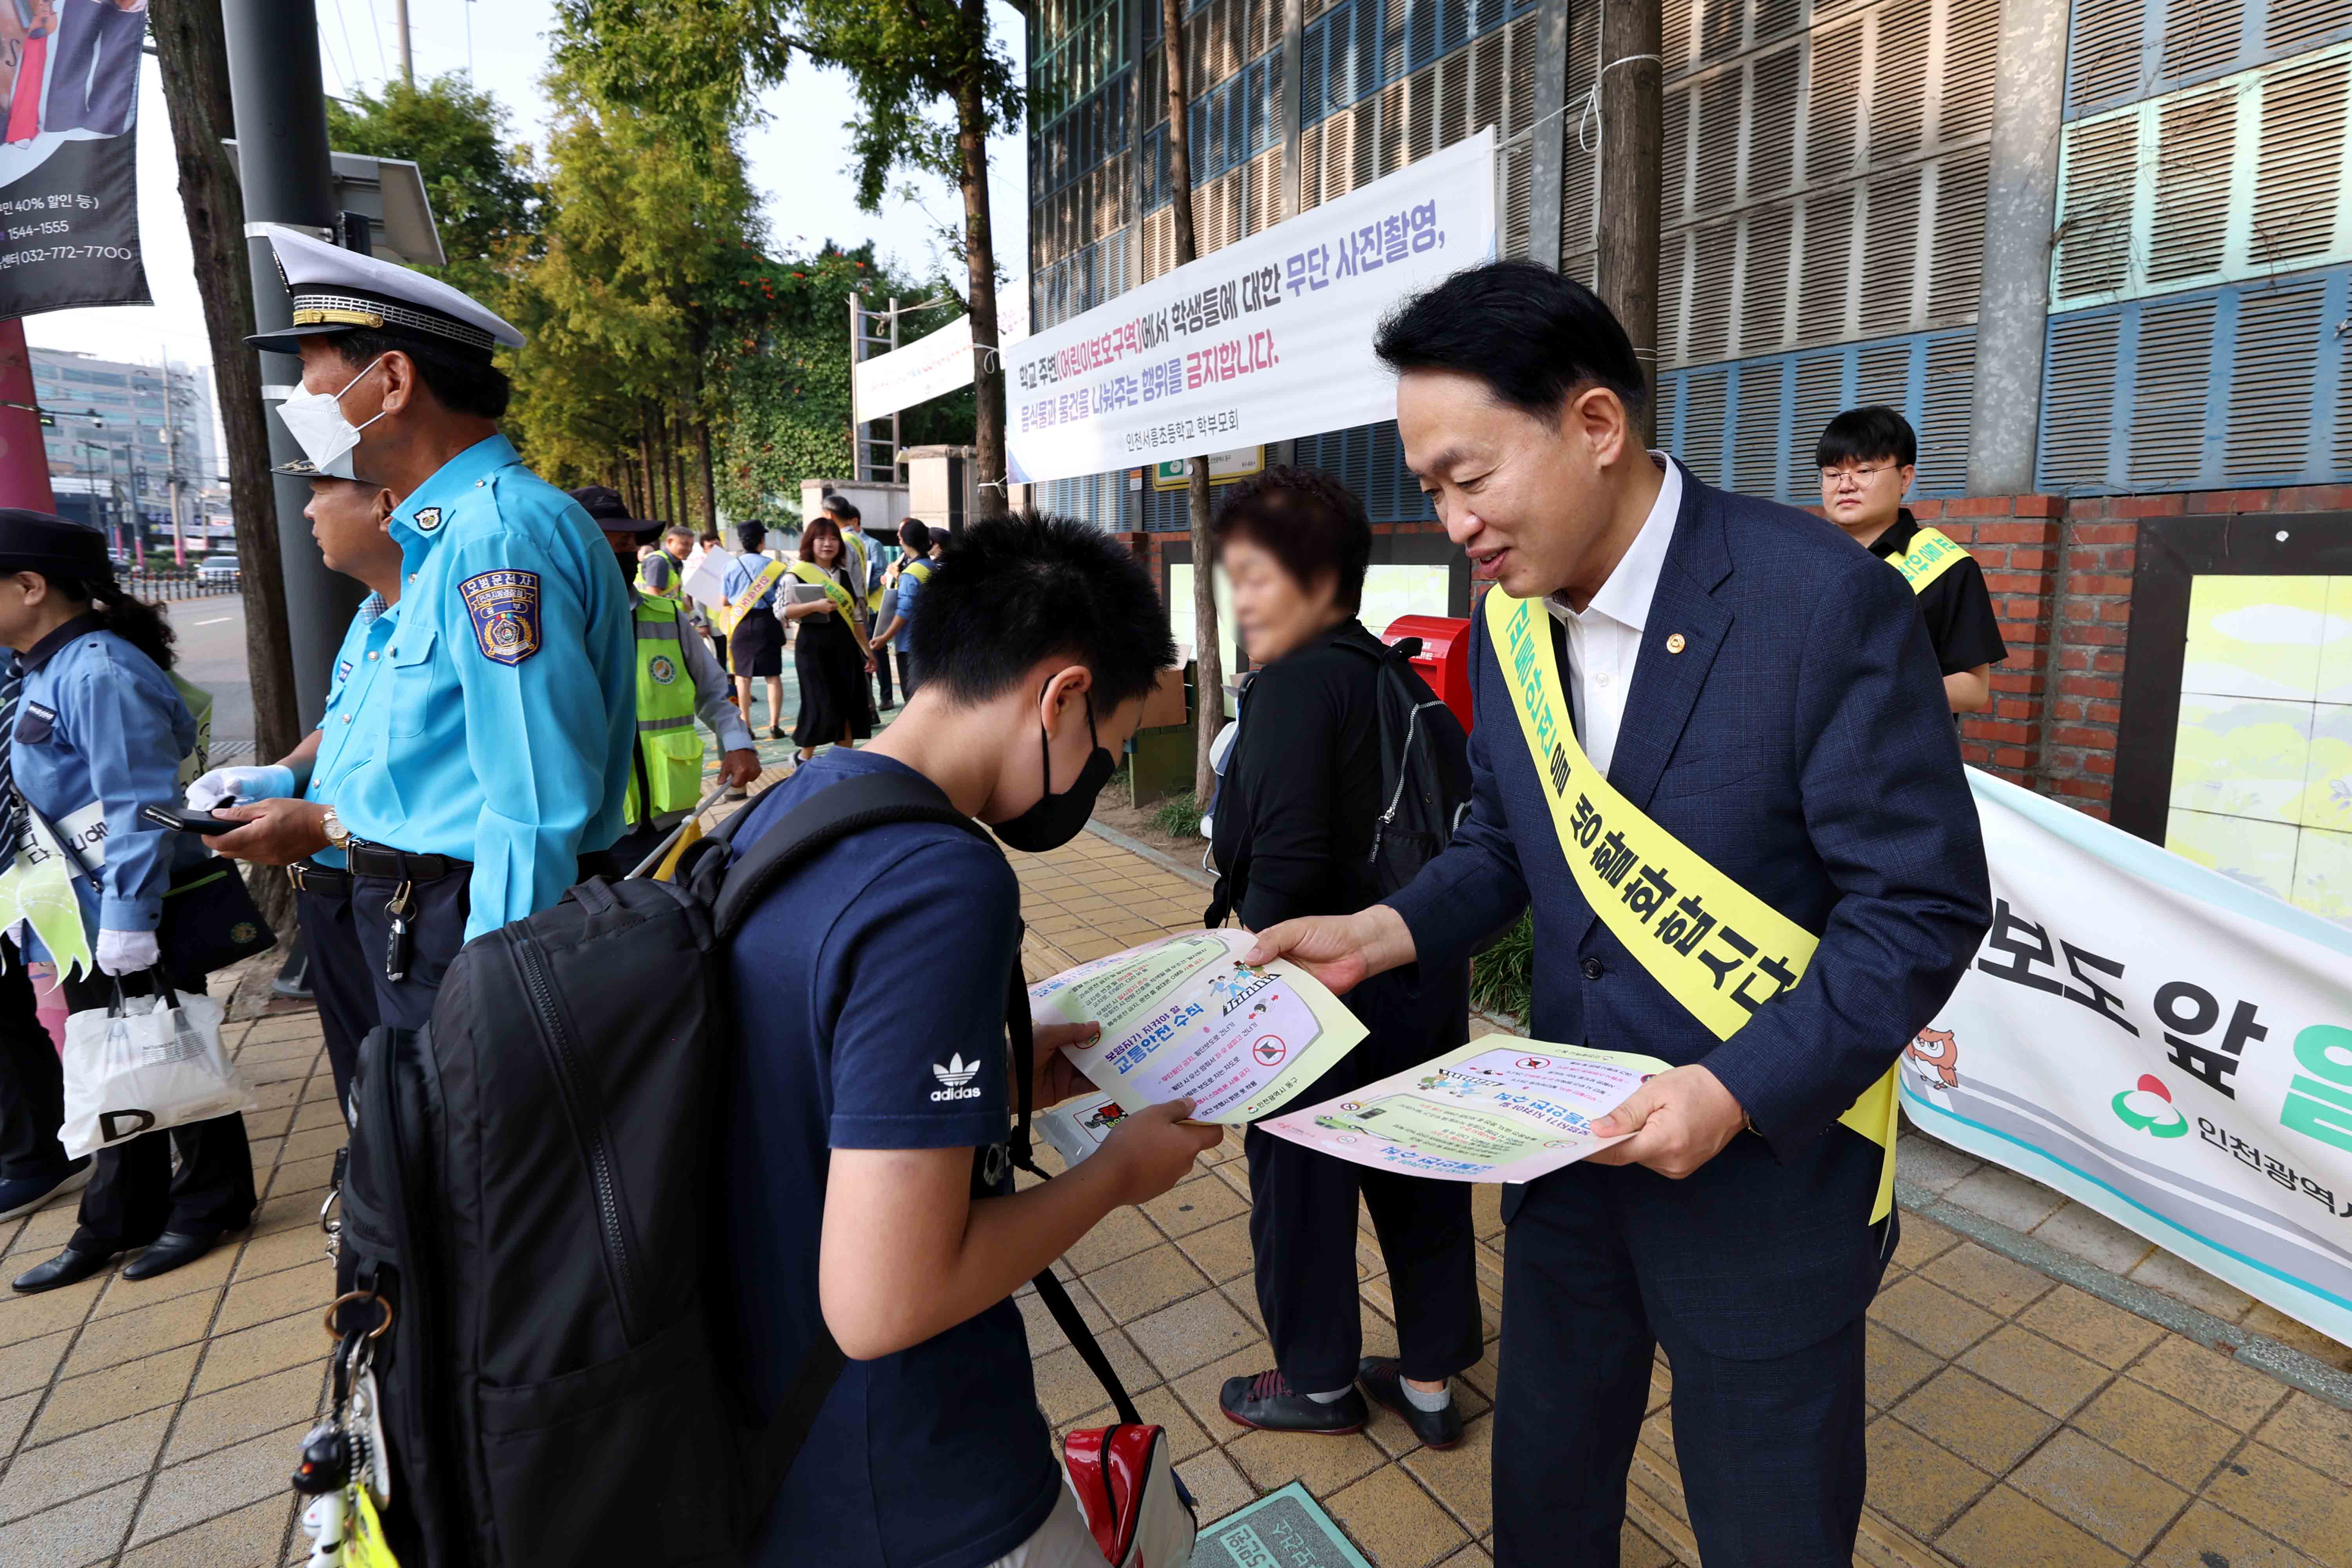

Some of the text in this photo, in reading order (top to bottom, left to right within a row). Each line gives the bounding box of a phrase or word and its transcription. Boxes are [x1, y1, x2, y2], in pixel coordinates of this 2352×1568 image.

[0, 194, 99, 215] 민 40% 할인 등)
[8, 220, 69, 240] 1544-1555
[0, 246, 132, 270] 센터 032-772-7700
[1020, 361, 1037, 391] 학교
[1172, 280, 1238, 336] 학생들에
[1242, 263, 1281, 313] 대한
[1286, 243, 1329, 297] 무단
[1336, 199, 1445, 279] 사진촬영,
[1022, 328, 1279, 433] 음식물과 물건을 나눠주는 행위를 금지합니다.
[1126, 408, 1240, 452] 인천서흥초등학교 학부모회
[466, 574, 532, 593] 모범운전자
[1506, 600, 1797, 1018] 교통안전을 생활화합시다
[1966, 898, 2140, 1038] 보도
[2154, 981, 2269, 1100] 앞
[1105, 1005, 1181, 1062] 보행자가 지켜야 할
[1113, 1002, 1205, 1075] 교통안전 수칙
[1219, 1022, 1236, 1037] 건너기
[1171, 1080, 1184, 1091] 횡단
[1183, 1076, 1191, 1085] 시
[1189, 1069, 1200, 1080] 우선
[1199, 1056, 1216, 1071] 멈춰서
[1241, 1022, 1258, 1036] 건너기
[1197, 1077, 1215, 1091] 보도로
[1223, 1056, 1241, 1071] 차도로
[1238, 1066, 1251, 1078] 금지
[931, 1086, 981, 1102] adidas
[1256, 1076, 1299, 1108] 인천광역시 동구
[99, 1109, 156, 1143] D
[1201, 1106, 1214, 1117] 야간
[1512, 1104, 1546, 1119] 지켜야
[1546, 1117, 1591, 1136] 보행자가
[2198, 1116, 2352, 1218] 인천광역
[1226, 1528, 1267, 1568] 5만원
